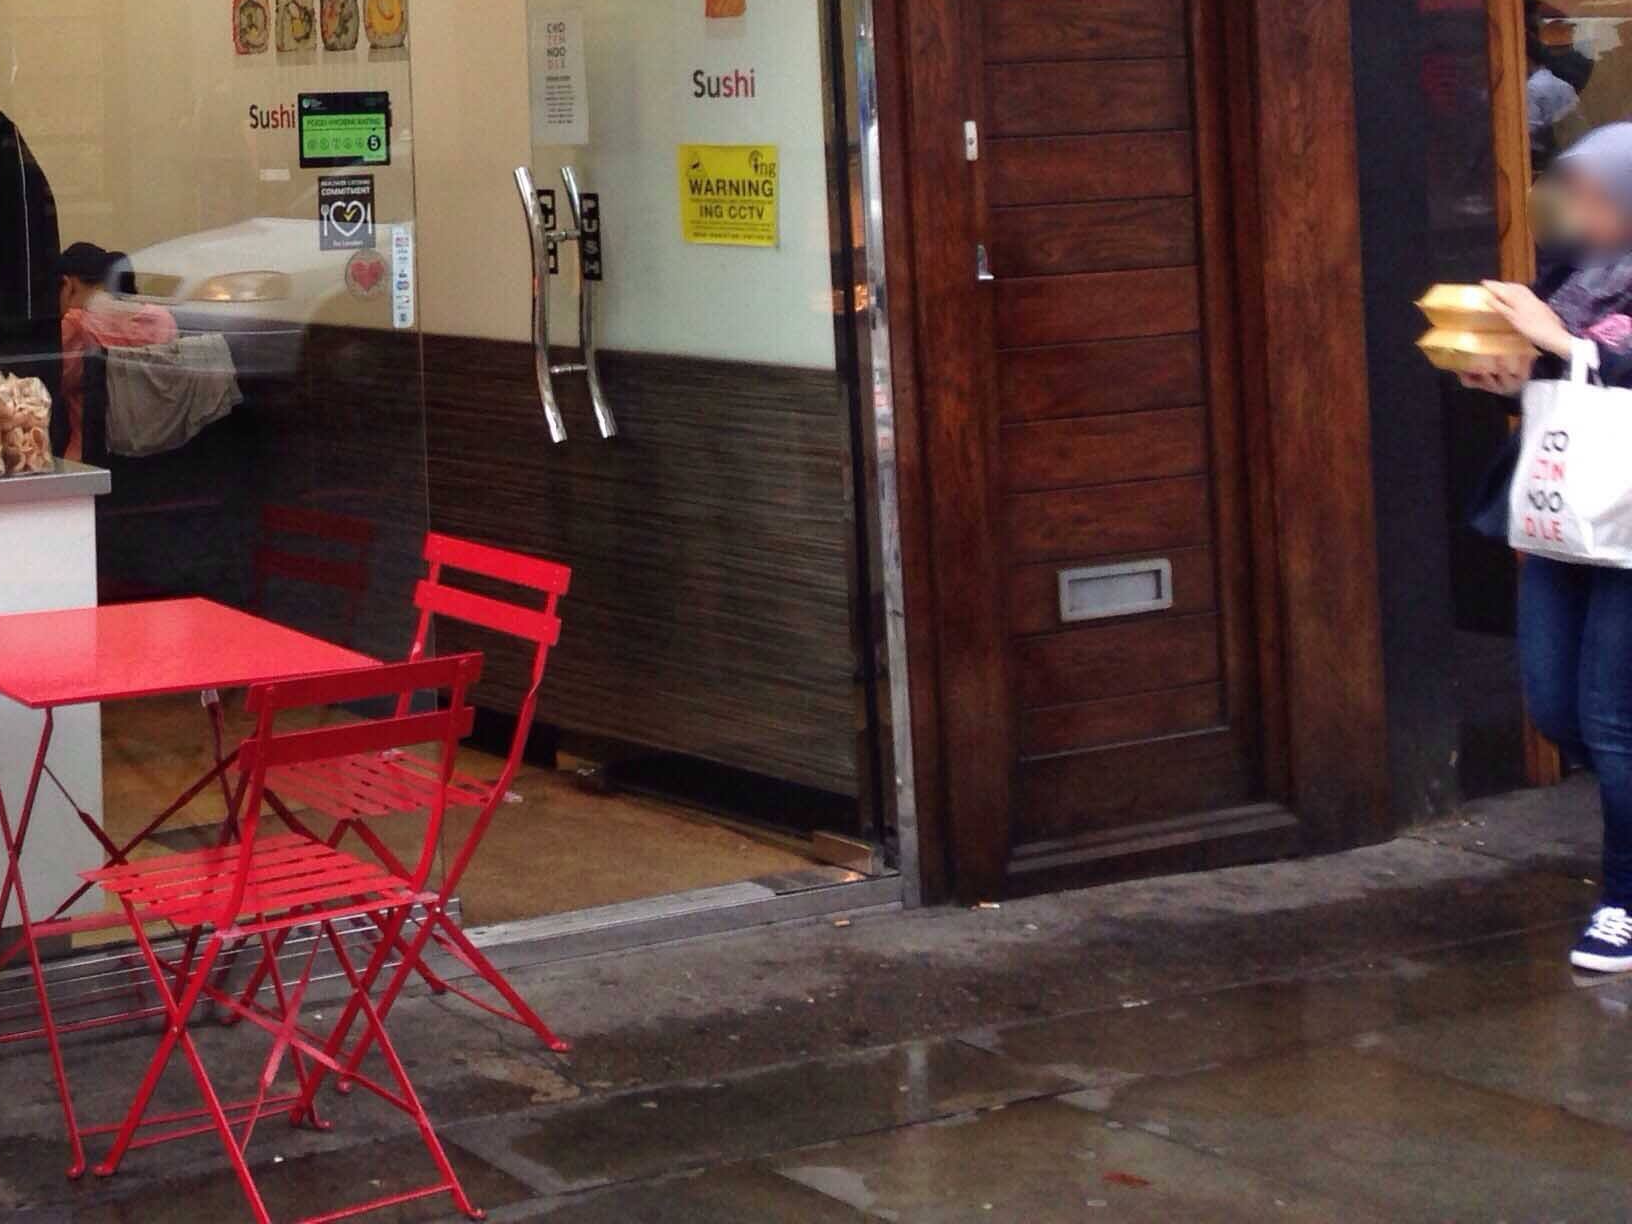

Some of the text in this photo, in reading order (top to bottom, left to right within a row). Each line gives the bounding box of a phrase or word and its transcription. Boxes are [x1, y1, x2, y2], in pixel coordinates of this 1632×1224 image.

[692, 67, 756, 99] Sushi
[248, 103, 297, 129] Sushi
[688, 178, 774, 198] WARNING
[728, 205, 765, 221] CCTV
